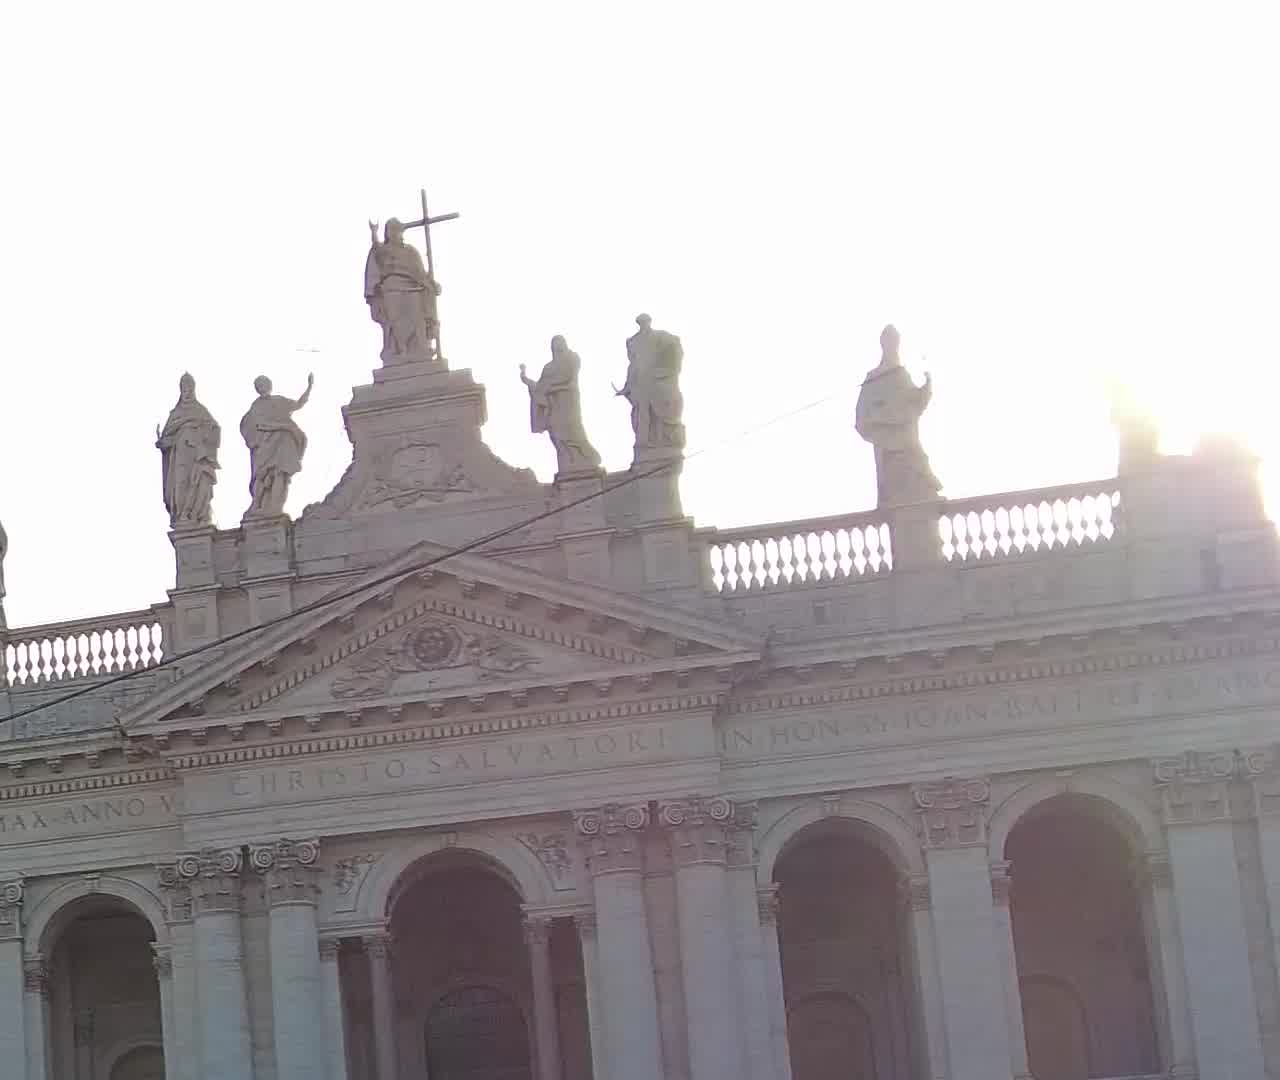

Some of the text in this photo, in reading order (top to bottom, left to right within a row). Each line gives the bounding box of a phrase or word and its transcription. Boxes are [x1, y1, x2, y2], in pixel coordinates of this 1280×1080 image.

[231, 727, 668, 798] CHRISTO SALVATORI
[61, 797, 145, 825] ANNO
